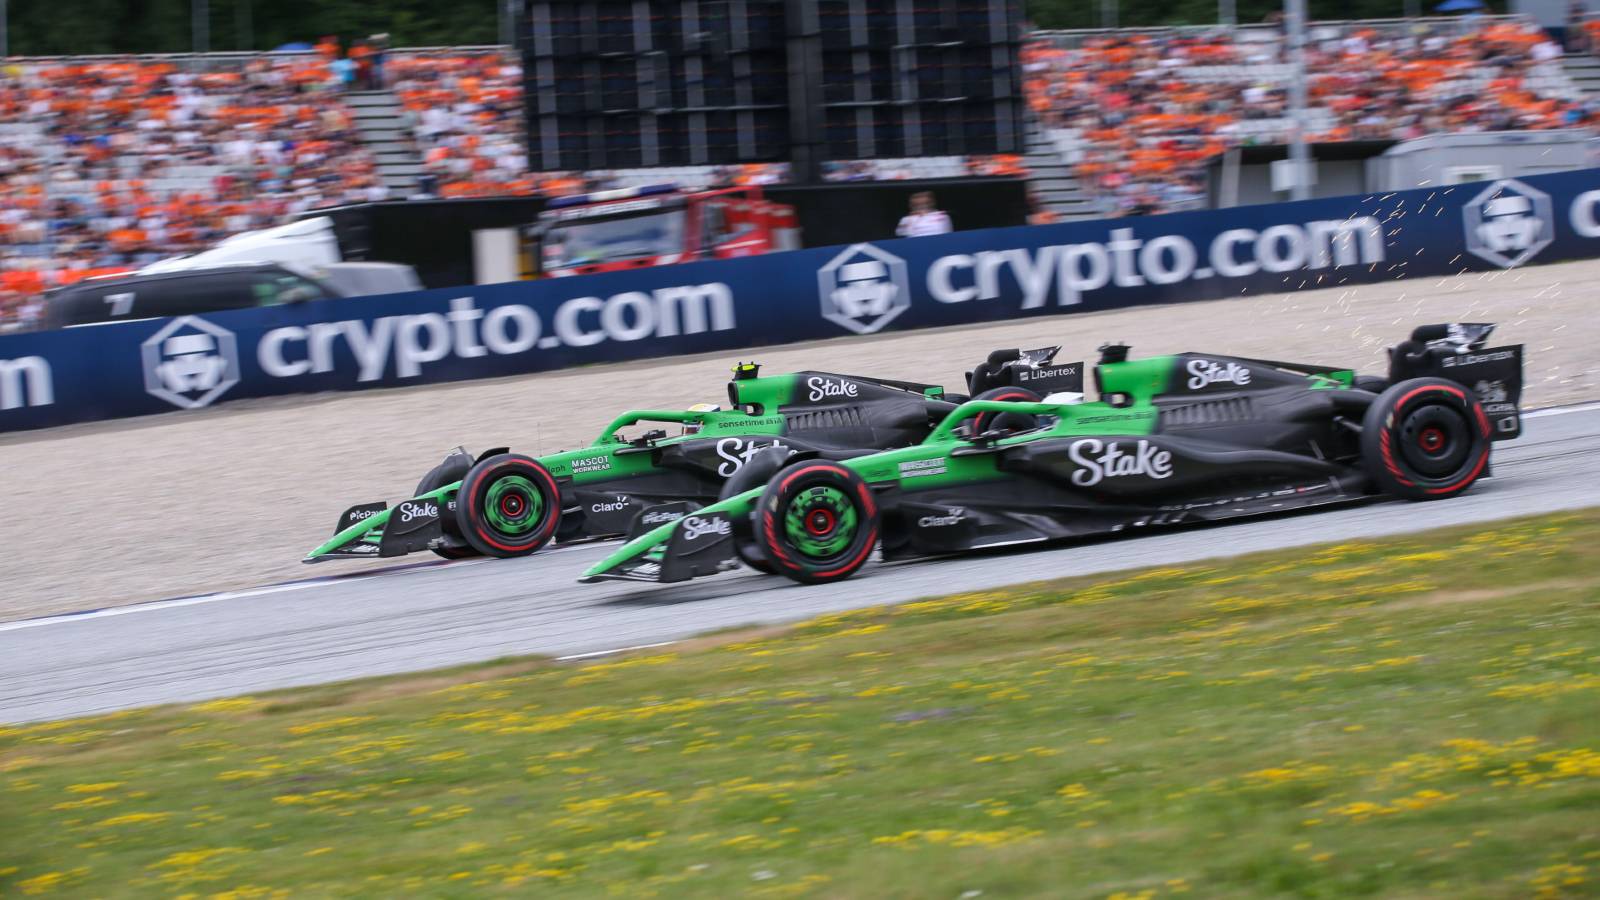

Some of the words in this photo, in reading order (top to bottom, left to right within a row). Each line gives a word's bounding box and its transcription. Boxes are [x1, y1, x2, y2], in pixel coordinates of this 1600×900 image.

[926, 215, 1385, 310] crypto.com
[257, 281, 736, 382] crypto.com
[1031, 367, 1076, 380] Libertex
[1186, 359, 1251, 390] Stake
[807, 376, 858, 402] Stake
[718, 419, 764, 429] sensetime
[571, 455, 609, 468] MASCOT
[573, 463, 611, 474] WORKWEAR
[1068, 438, 1173, 487] Stake
[400, 502, 440, 523] Stake
[592, 500, 625, 513] Claro
[683, 516, 732, 541] Stake
